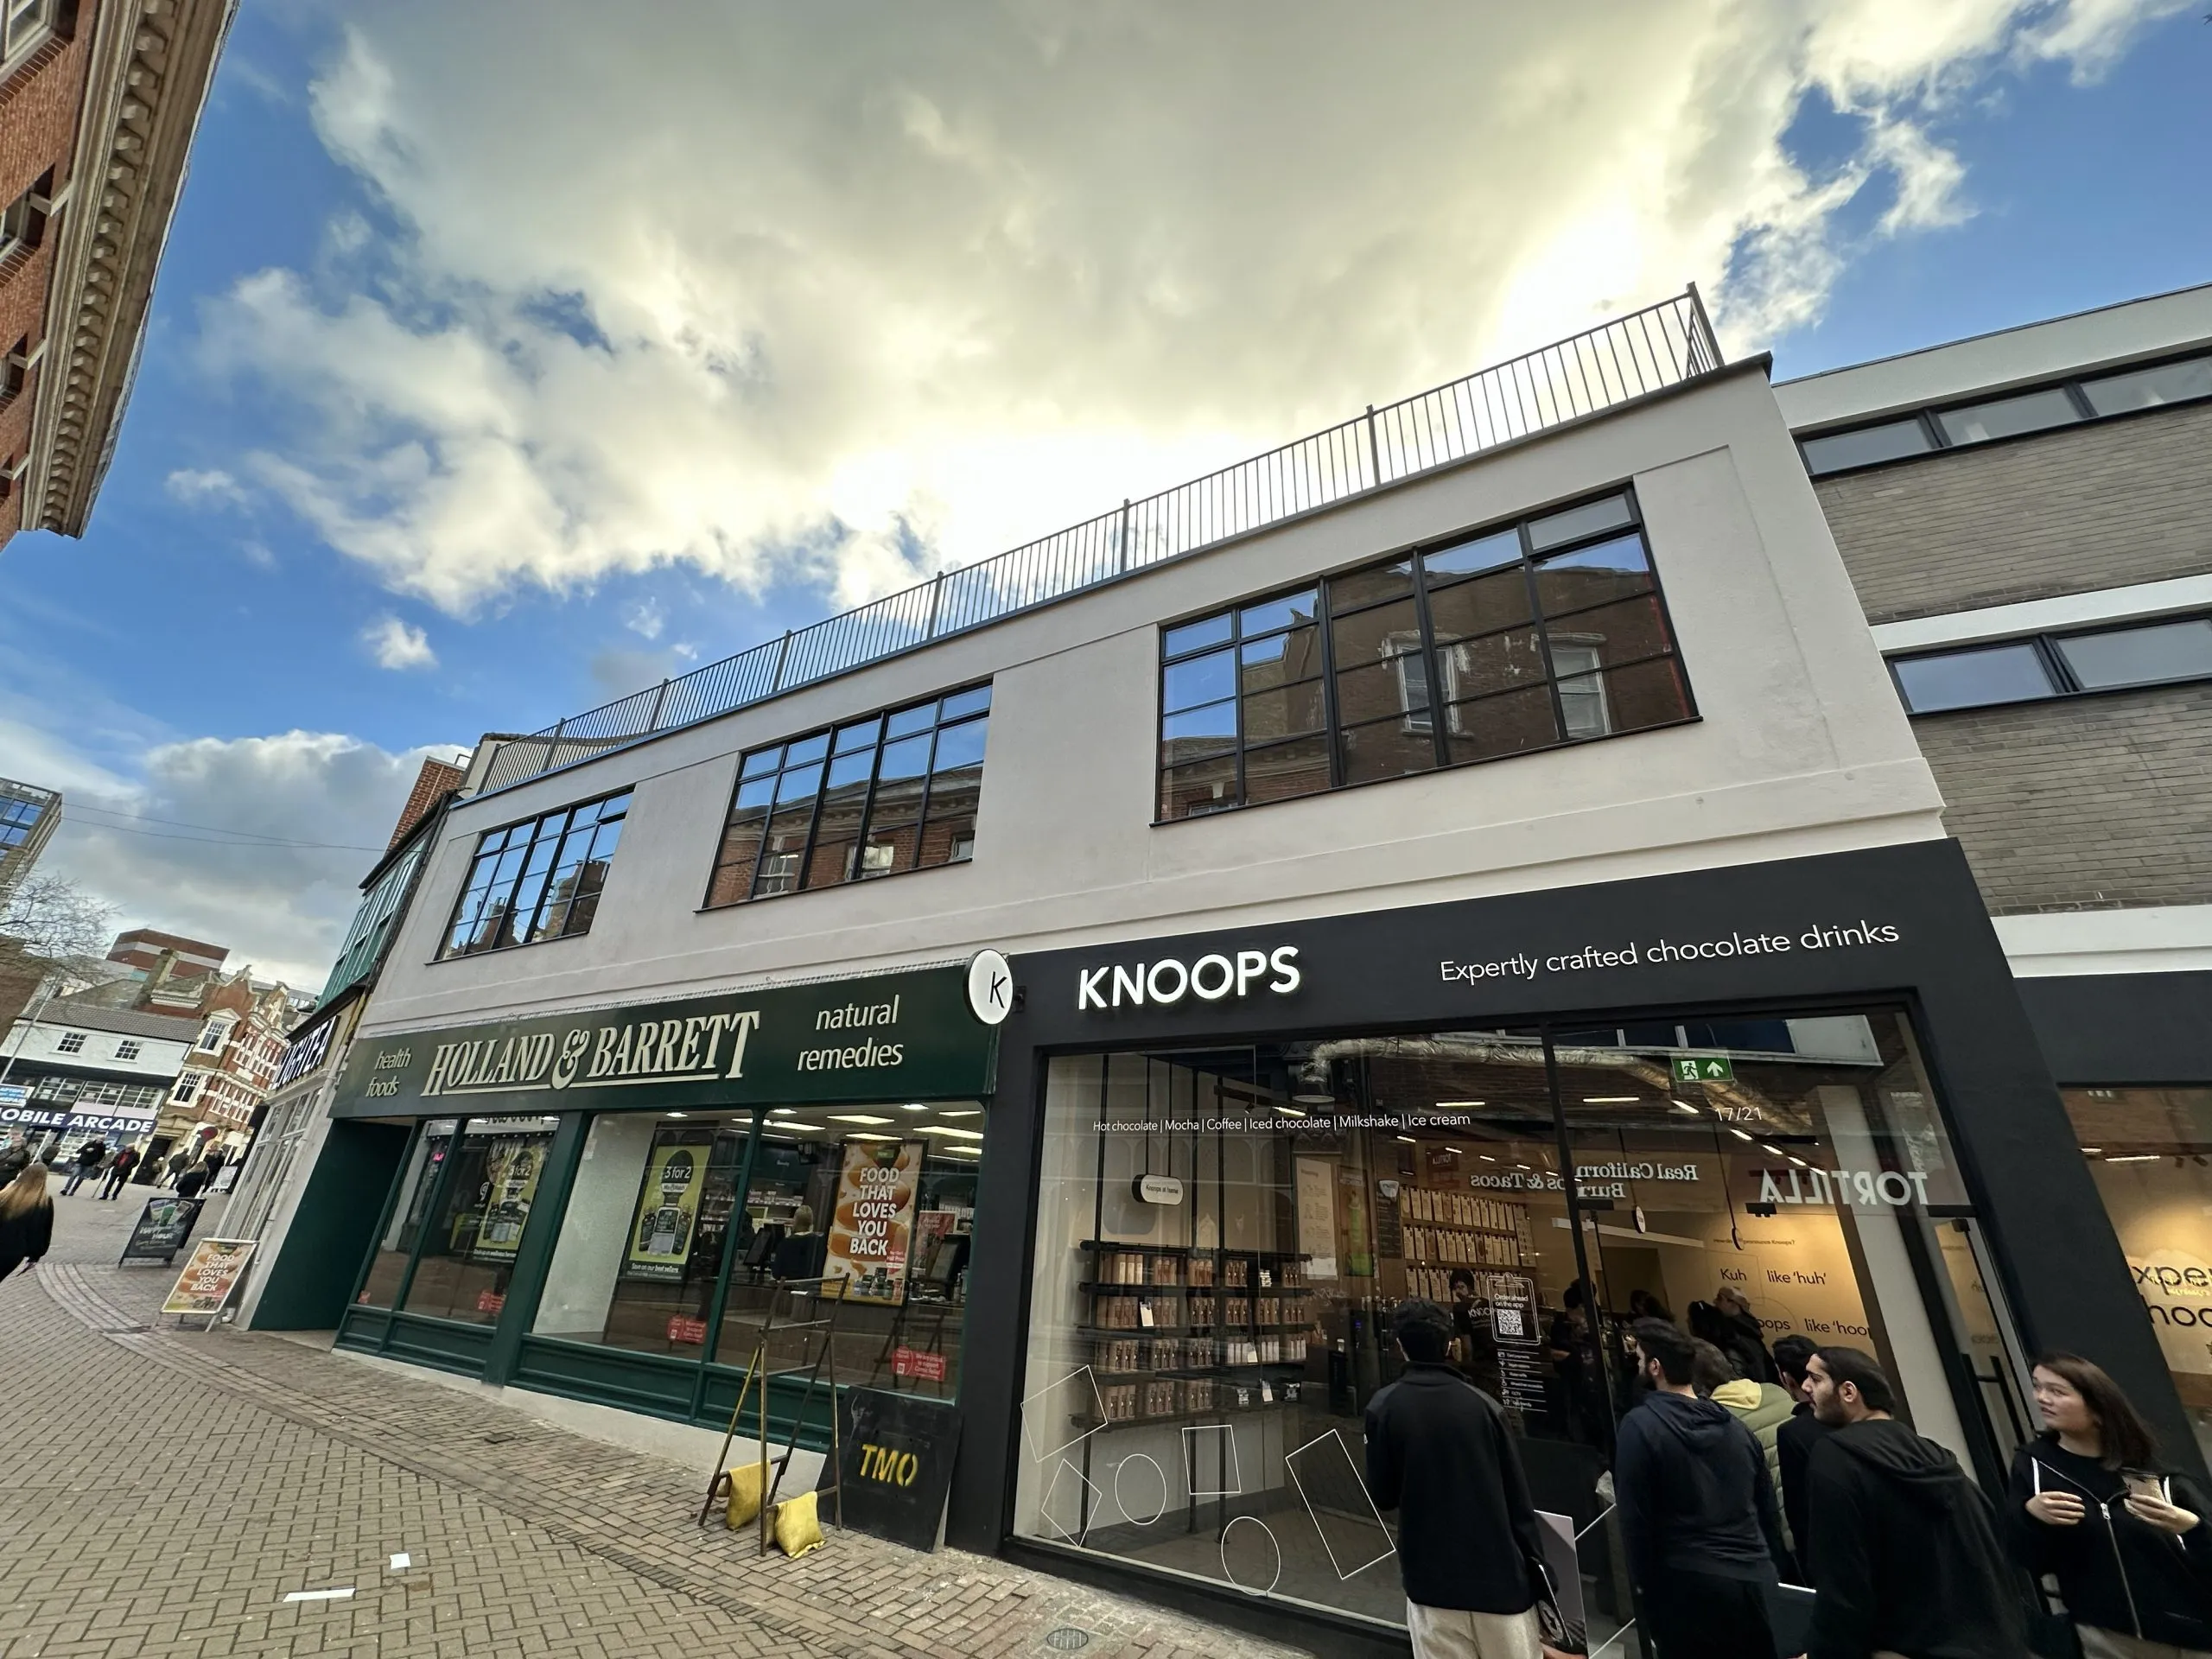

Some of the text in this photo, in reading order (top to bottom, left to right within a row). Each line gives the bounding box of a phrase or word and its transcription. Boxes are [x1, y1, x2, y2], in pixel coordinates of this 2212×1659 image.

[1440, 920, 1899, 985] Expertly crafted chocolate drinks
[1077, 946, 1300, 1010] KNOOPS
[989, 970, 1007, 1008] K
[816, 995, 899, 1031] natural
[374, 1047, 412, 1070] health
[421, 1010, 760, 1096] HOLLAND & BARRETT
[797, 1038, 904, 1071] remedies
[365, 1076, 400, 1097] foods
[0, 1108, 154, 1133] OBILE ARCADE
[1092, 1114, 1471, 1132] Hot chocolate Mocha Coffee Iced chocolate Milkshake Ice cream
[1713, 1106, 1763, 1122] 17/21
[664, 1166, 692, 1179] 3 for 2
[860, 1167, 899, 1183] FOOD
[860, 1185, 897, 1201] THAT
[852, 1202, 897, 1219] LOVES
[857, 1219, 887, 1237] YOU
[849, 1237, 888, 1256] BACK
[207, 1254, 235, 1262] FOOD
[1720, 1268, 1747, 1281] Kuh
[1767, 1270, 1791, 1283] like
[2132, 1265, 2212, 1295] xpe
[1494, 1293, 1510, 1301] Order
[1757, 1318, 1870, 1336] oops like 'hoo
[859, 1444, 918, 1487] TMO
